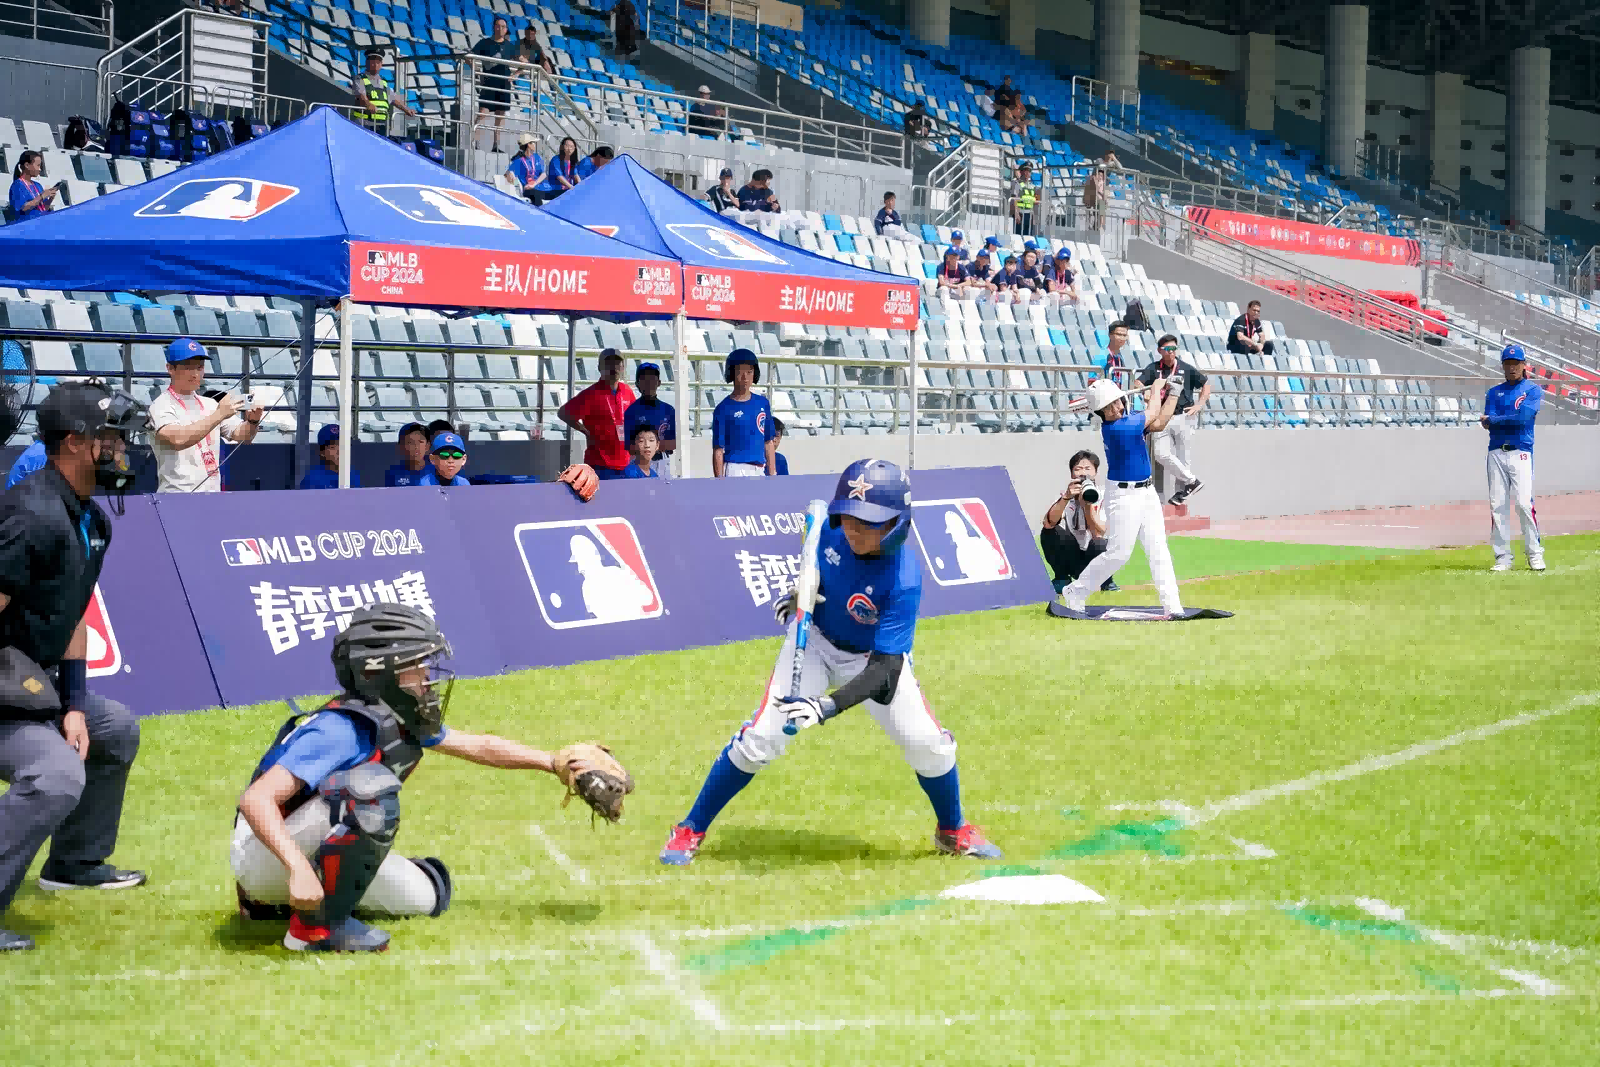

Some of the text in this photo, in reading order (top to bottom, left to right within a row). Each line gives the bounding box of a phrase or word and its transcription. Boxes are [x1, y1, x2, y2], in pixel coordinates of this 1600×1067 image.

[388, 251, 418, 267] MLB
[360, 265, 424, 284] CUP 2024
[483, 262, 589, 296] 主队/HOME
[649, 267, 671, 281] MLB
[709, 274, 732, 289] MLB
[381, 285, 403, 294] CHINA
[633, 280, 675, 296] CUP 2024
[692, 286, 736, 303] CUP 2024
[779, 285, 855, 314] 主队/HOME
[884, 301, 897, 314] CUP
[1519, 453, 1528, 461] 13
[736, 512, 806, 537] MLB CUP
[257, 528, 425, 565] MLB CUP 2024
